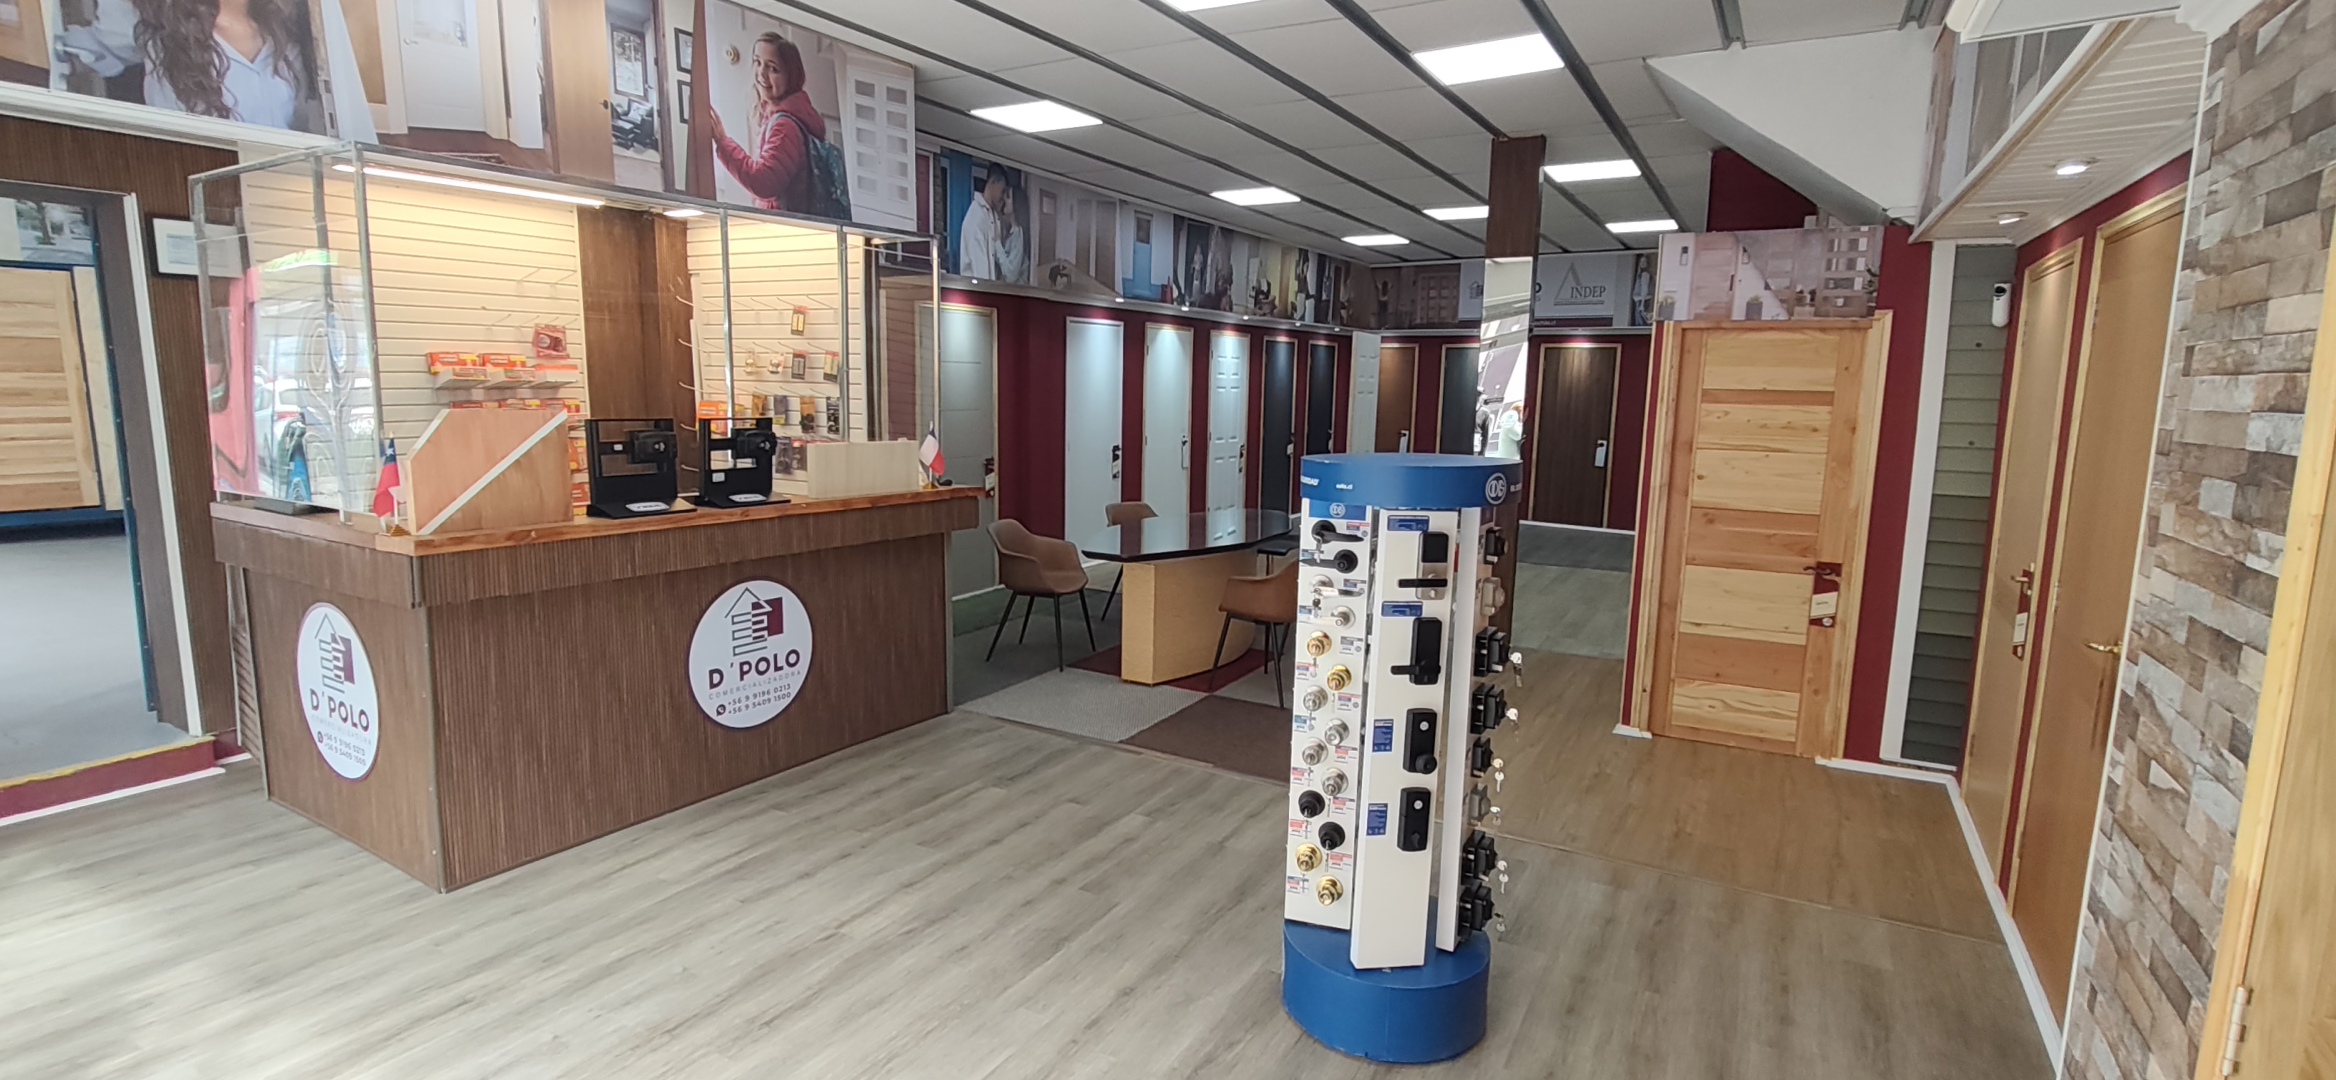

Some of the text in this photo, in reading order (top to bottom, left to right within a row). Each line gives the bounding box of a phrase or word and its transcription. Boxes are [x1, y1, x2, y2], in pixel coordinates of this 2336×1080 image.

[1570, 286, 1606, 299] INDEP
[708, 670, 801, 700] COMERCIALIZADORA
[728, 696, 742, 706] +56
[752, 689, 771, 700] 9196
[773, 683, 791, 694] 0213
[728, 705, 742, 715] +56
[752, 697, 771, 709] 5409
[773, 691, 791, 702] 1500
